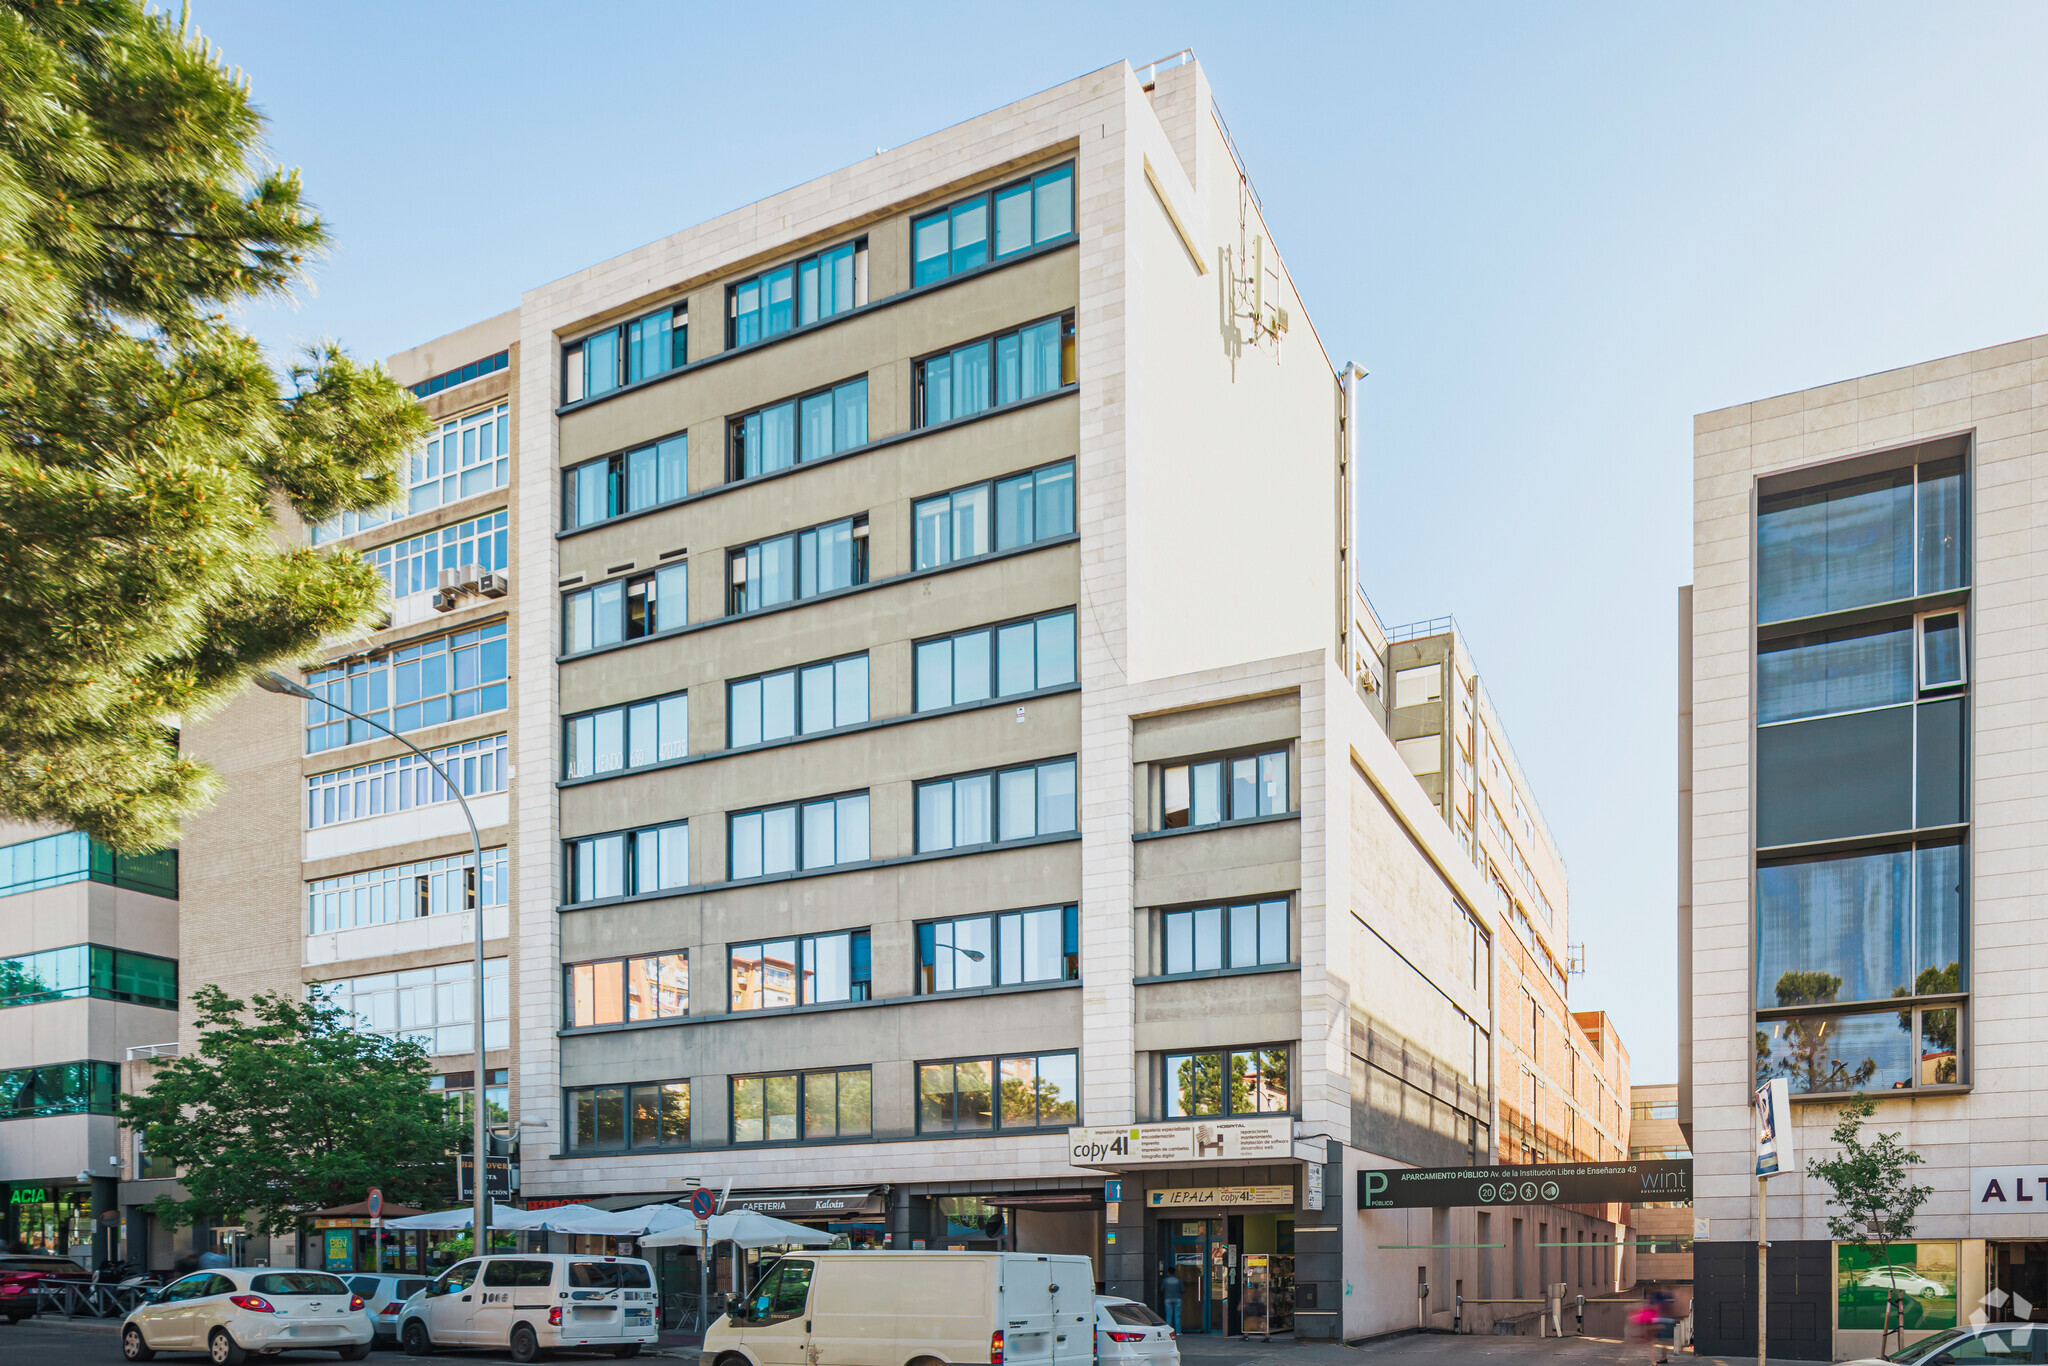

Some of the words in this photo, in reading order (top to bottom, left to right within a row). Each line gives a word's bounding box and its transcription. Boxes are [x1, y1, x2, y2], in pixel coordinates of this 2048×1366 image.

[1401, 1172, 1456, 1180] APARCAMIENTO
[1458, 1170, 1488, 1179] PÚBLICO
[1520, 1168, 1556, 1177] Institución
[1558, 1168, 1574, 1176] Libre
[1587, 1166, 1626, 1175] Enseñanza
[1640, 1168, 1686, 1188] wint
[1366, 1172, 1388, 1206] P
[1170, 1191, 1214, 1204] IEPALA
[742, 1202, 786, 1210] CAFETERIA
